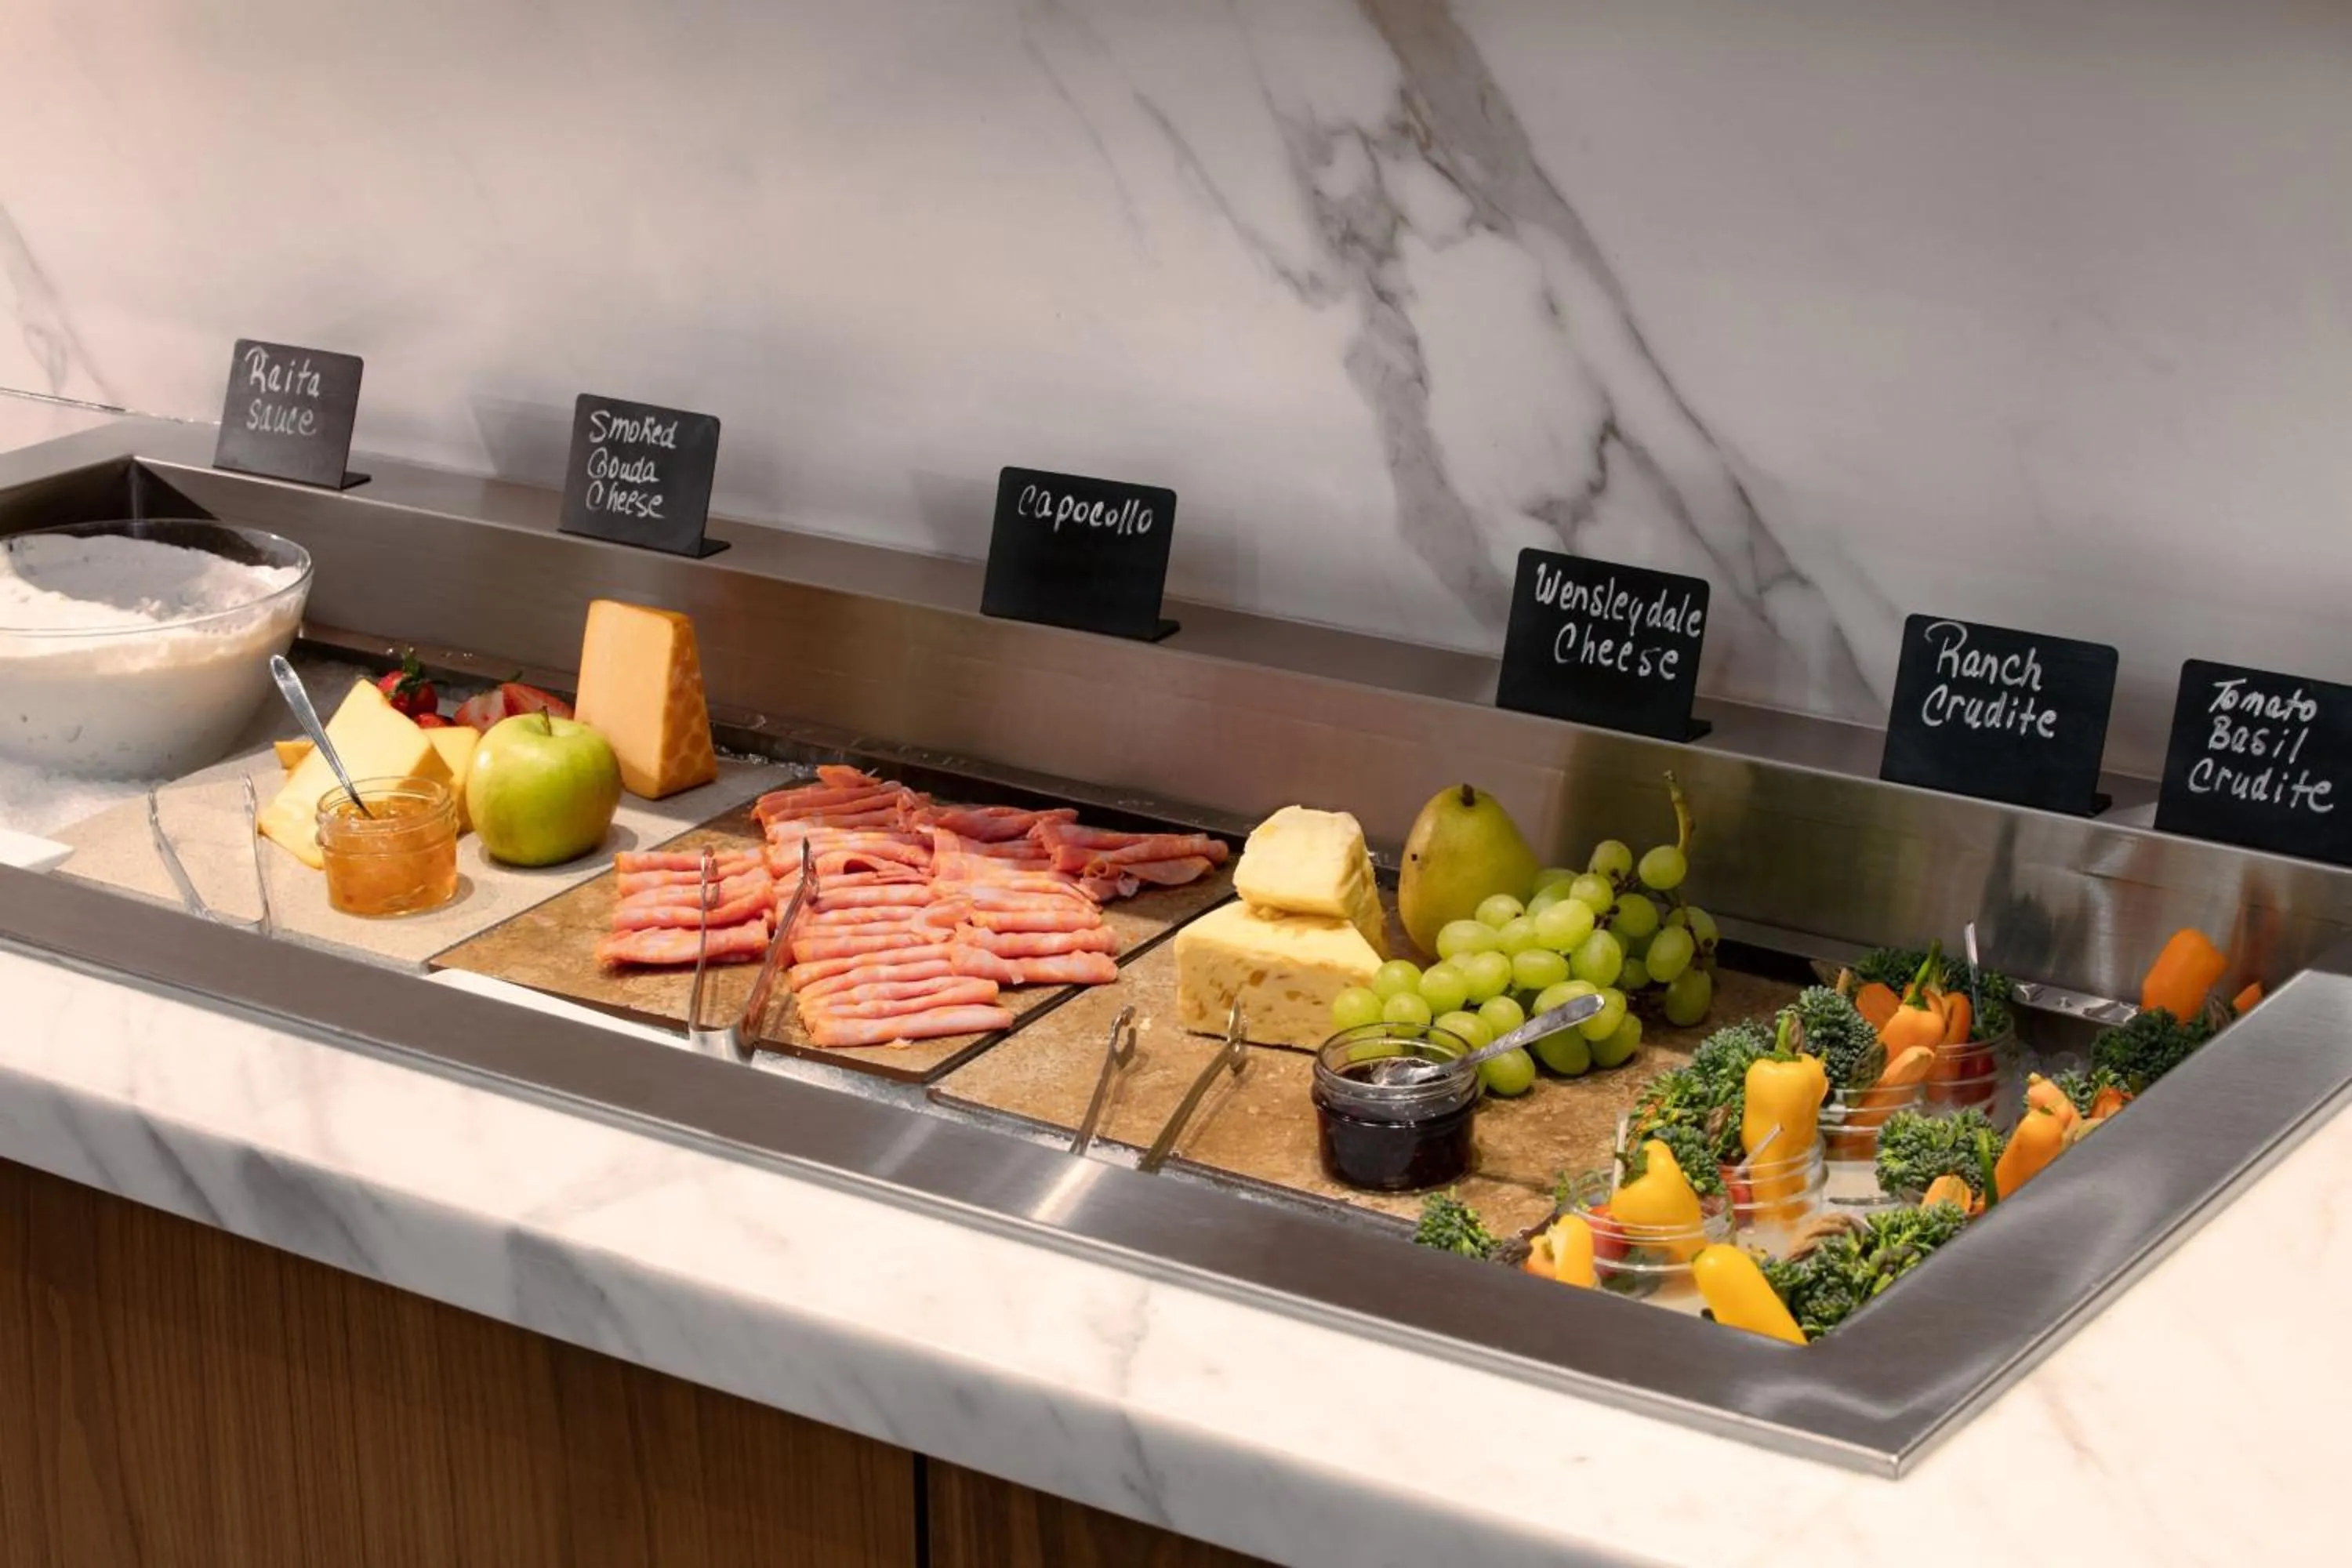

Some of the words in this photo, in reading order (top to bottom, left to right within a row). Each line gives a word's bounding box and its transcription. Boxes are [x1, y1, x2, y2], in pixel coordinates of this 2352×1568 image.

[244, 345, 321, 398] Raita
[587, 446, 660, 484] Gouda
[586, 480, 666, 519] Cheese
[1018, 484, 1153, 535] Capocollo
[1534, 561, 1702, 637] Wensleydale
[1554, 622, 1679, 680] Cheese
[1923, 621, 2042, 691] Ranch
[1922, 684, 2058, 739] Crudite
[2208, 677, 2318, 722] Tomato
[2208, 714, 2310, 764] Basil
[2187, 757, 2335, 813] Crudite
